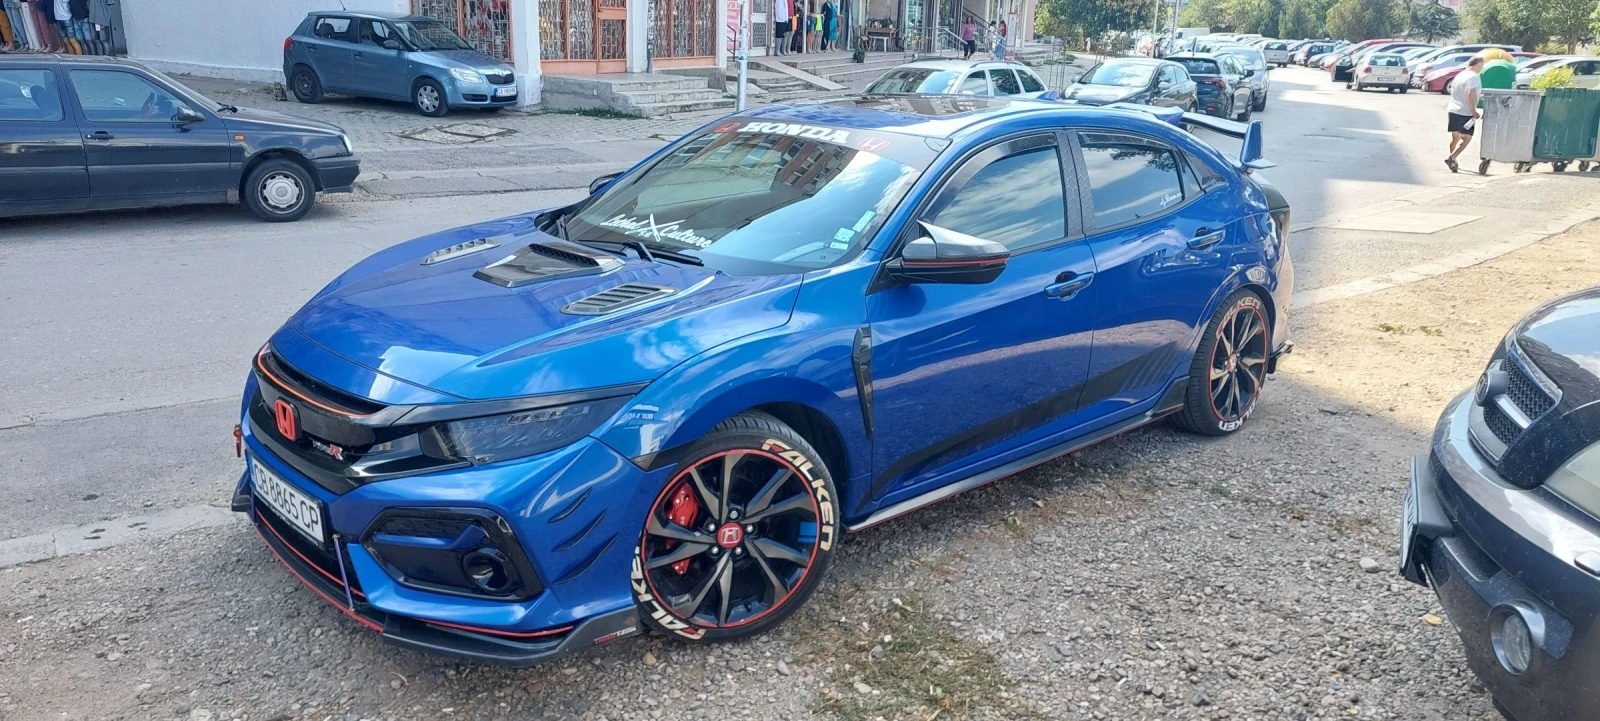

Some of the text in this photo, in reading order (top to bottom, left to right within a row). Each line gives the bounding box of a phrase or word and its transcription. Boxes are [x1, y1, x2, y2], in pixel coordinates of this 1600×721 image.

[737, 121, 851, 144] HONDA
[660, 224, 713, 248] Culture
[254, 463, 319, 532] CB 8865 CP
[762, 438, 834, 551] FALKEN
